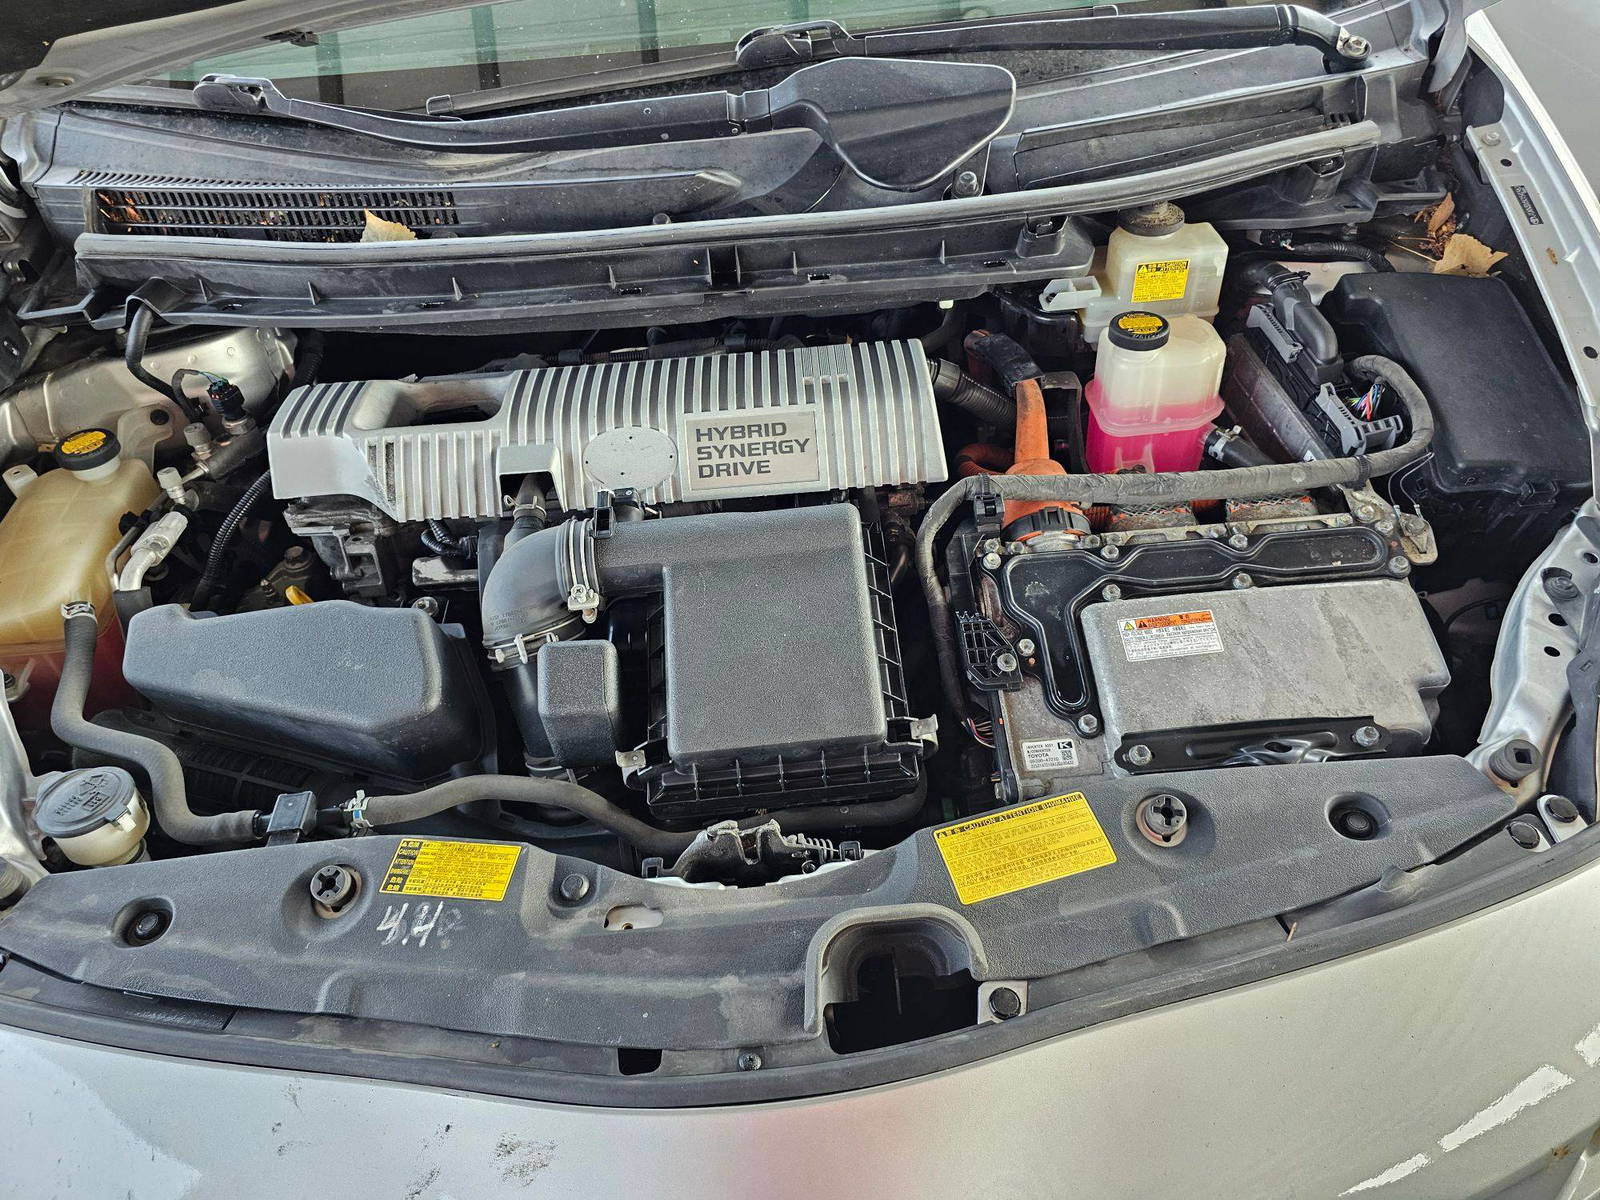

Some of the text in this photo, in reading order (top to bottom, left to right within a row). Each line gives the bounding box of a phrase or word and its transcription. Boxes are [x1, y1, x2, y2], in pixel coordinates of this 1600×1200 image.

[695, 422, 787, 442] HYBRID
[696, 438, 810, 461] SYNERGY
[698, 460, 771, 479] DRIVE
[963, 806, 1040, 832] CAUTION ATTENTION
